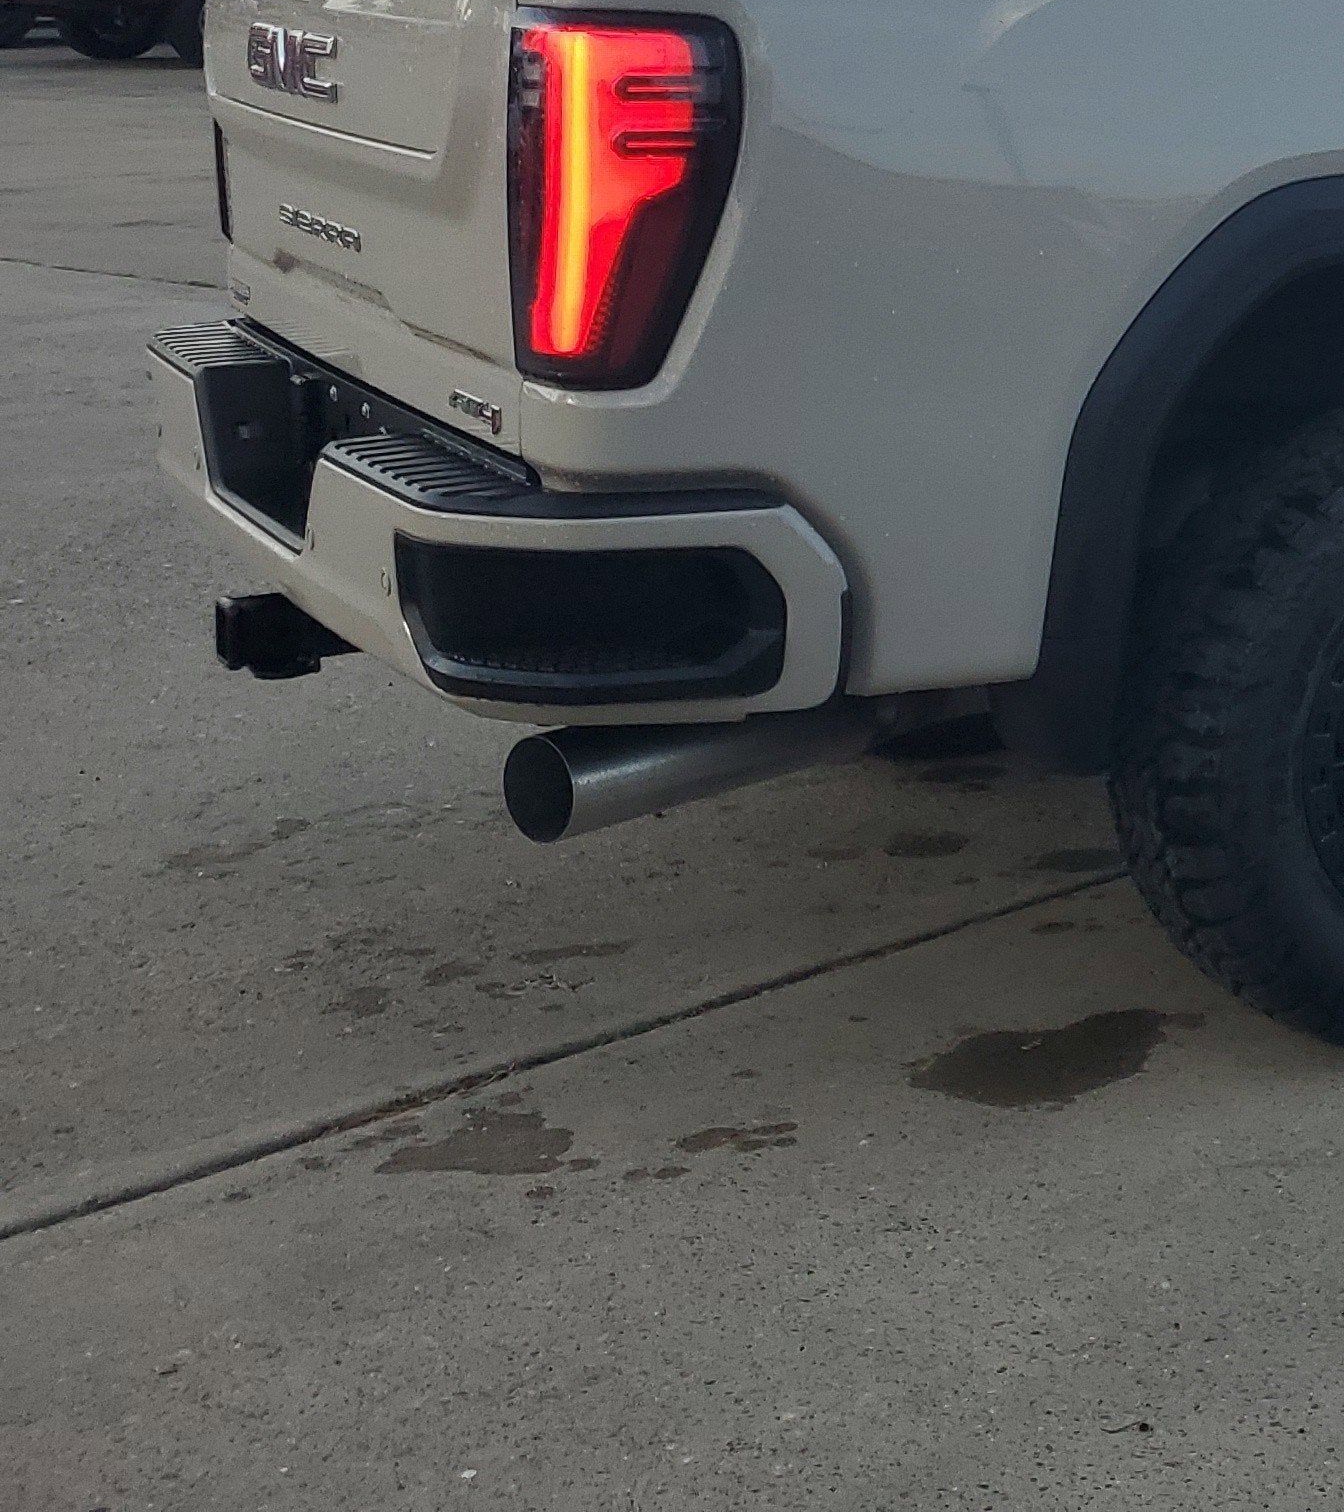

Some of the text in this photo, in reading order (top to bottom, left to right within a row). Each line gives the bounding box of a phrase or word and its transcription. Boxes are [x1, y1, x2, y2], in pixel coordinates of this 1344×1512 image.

[247, 22, 338, 103] GMC
[279, 202, 362, 253] SIERRA
[448, 388, 502, 435] AT4
